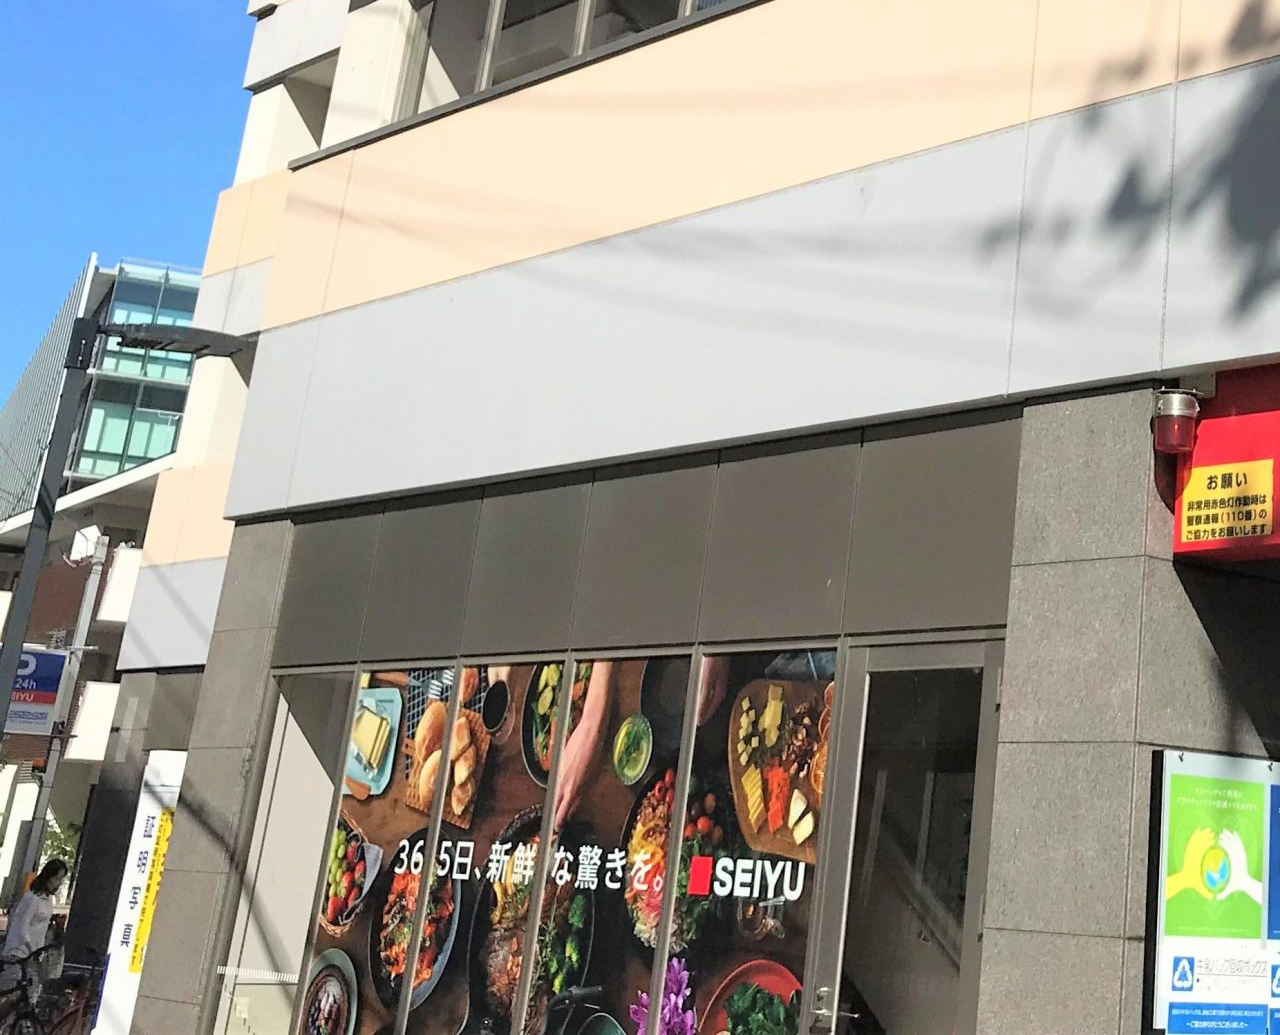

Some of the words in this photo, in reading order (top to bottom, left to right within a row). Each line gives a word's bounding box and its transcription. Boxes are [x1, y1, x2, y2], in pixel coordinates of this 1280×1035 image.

[1206, 472, 1248, 490] お願い
[1187, 494, 1267, 512] 非常用赤色灯作動時は
[1186, 523, 1267, 541] ご協力をお願いします
[120, 815, 157, 947] 証明写真
[714, 856, 807, 901] SEIYU
